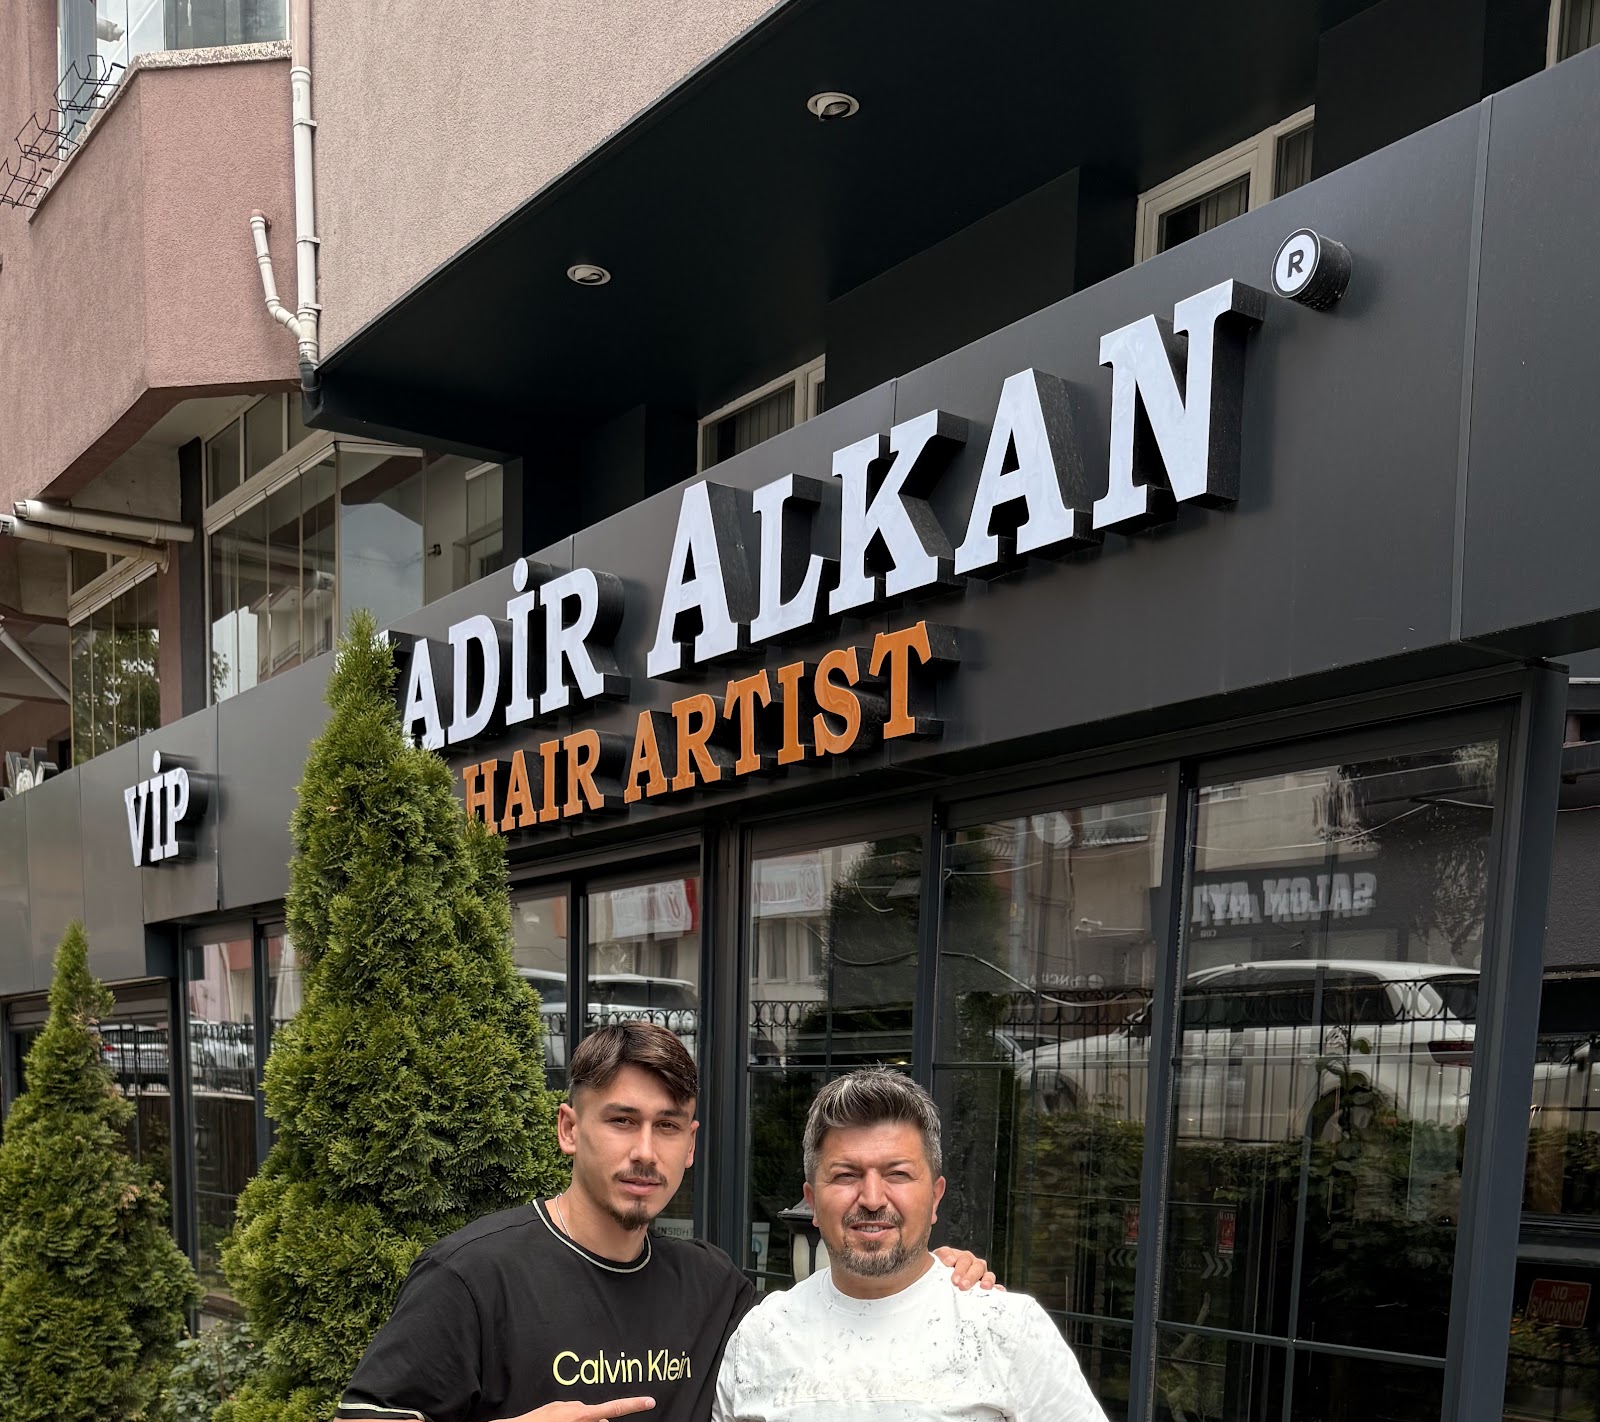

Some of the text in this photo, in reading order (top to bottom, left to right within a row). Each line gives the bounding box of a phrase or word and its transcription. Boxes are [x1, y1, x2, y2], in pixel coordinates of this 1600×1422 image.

[336, 279, 1235, 751] ADİR ALKAN
[463, 621, 932, 836] HAIR ARTIST
[124, 750, 190, 868] VİP
[1529, 1296, 1585, 1321] SMOKING
[1550, 1285, 1569, 1300] NO
[553, 1349, 692, 1386] Calvin Klein
